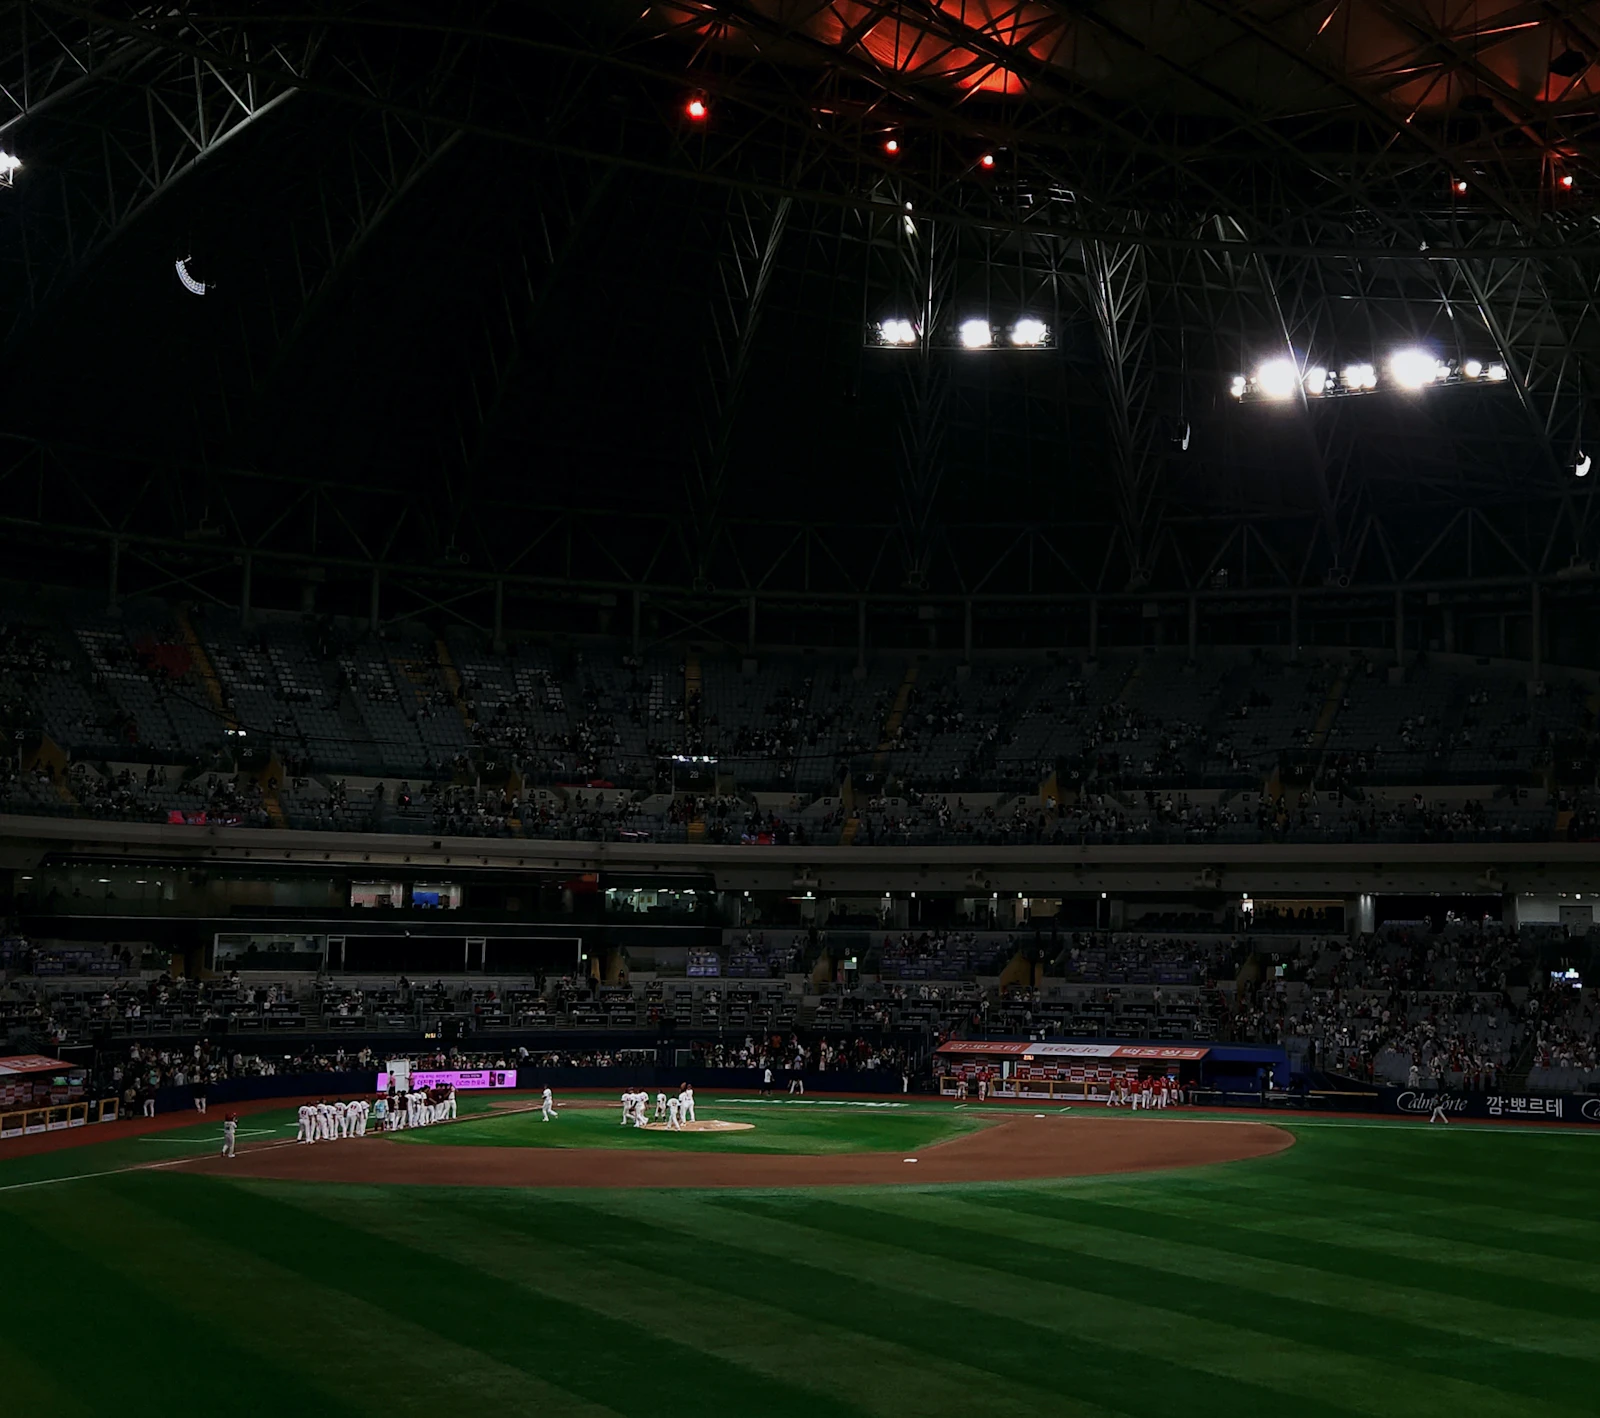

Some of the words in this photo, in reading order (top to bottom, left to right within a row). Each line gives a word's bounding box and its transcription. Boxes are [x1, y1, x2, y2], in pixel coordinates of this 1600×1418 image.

[15, 731, 25, 740] 25
[486, 761, 495, 771] 27
[1572, 761, 1582, 770] 32
[1070, 770, 1080, 780] 30
[1295, 766, 1304, 776] 31
[844, 947, 850, 956] 8
[1039, 949, 1045, 958] 9
[1272, 952, 1280, 961] 10
